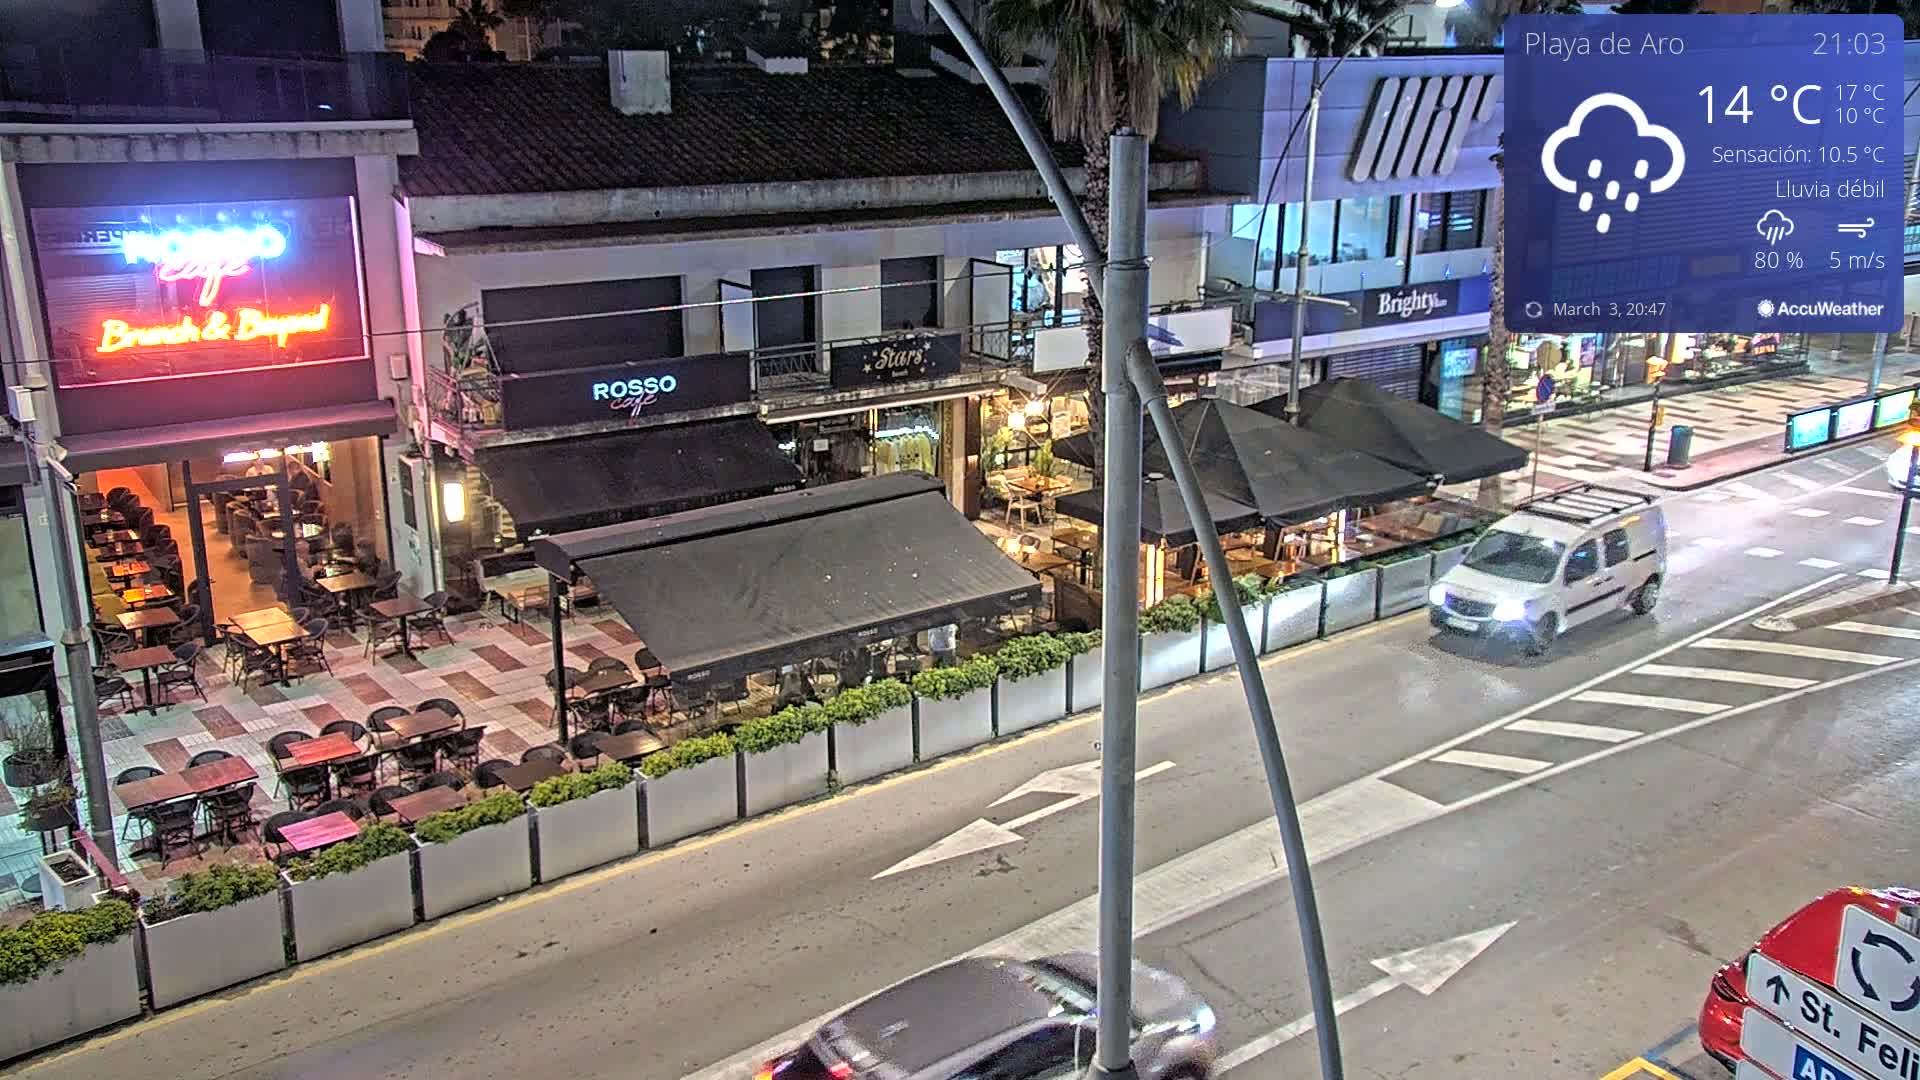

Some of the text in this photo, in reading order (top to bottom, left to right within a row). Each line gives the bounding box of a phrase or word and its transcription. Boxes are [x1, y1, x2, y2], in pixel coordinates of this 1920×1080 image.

[1377, 289, 1437, 318] Brighty
[96, 315, 200, 352] Brunch
[200, 311, 231, 341] &
[874, 347, 924, 370] Stars
[592, 375, 677, 401] ROSSO
[1801, 991, 1920, 1080] St. Feli
